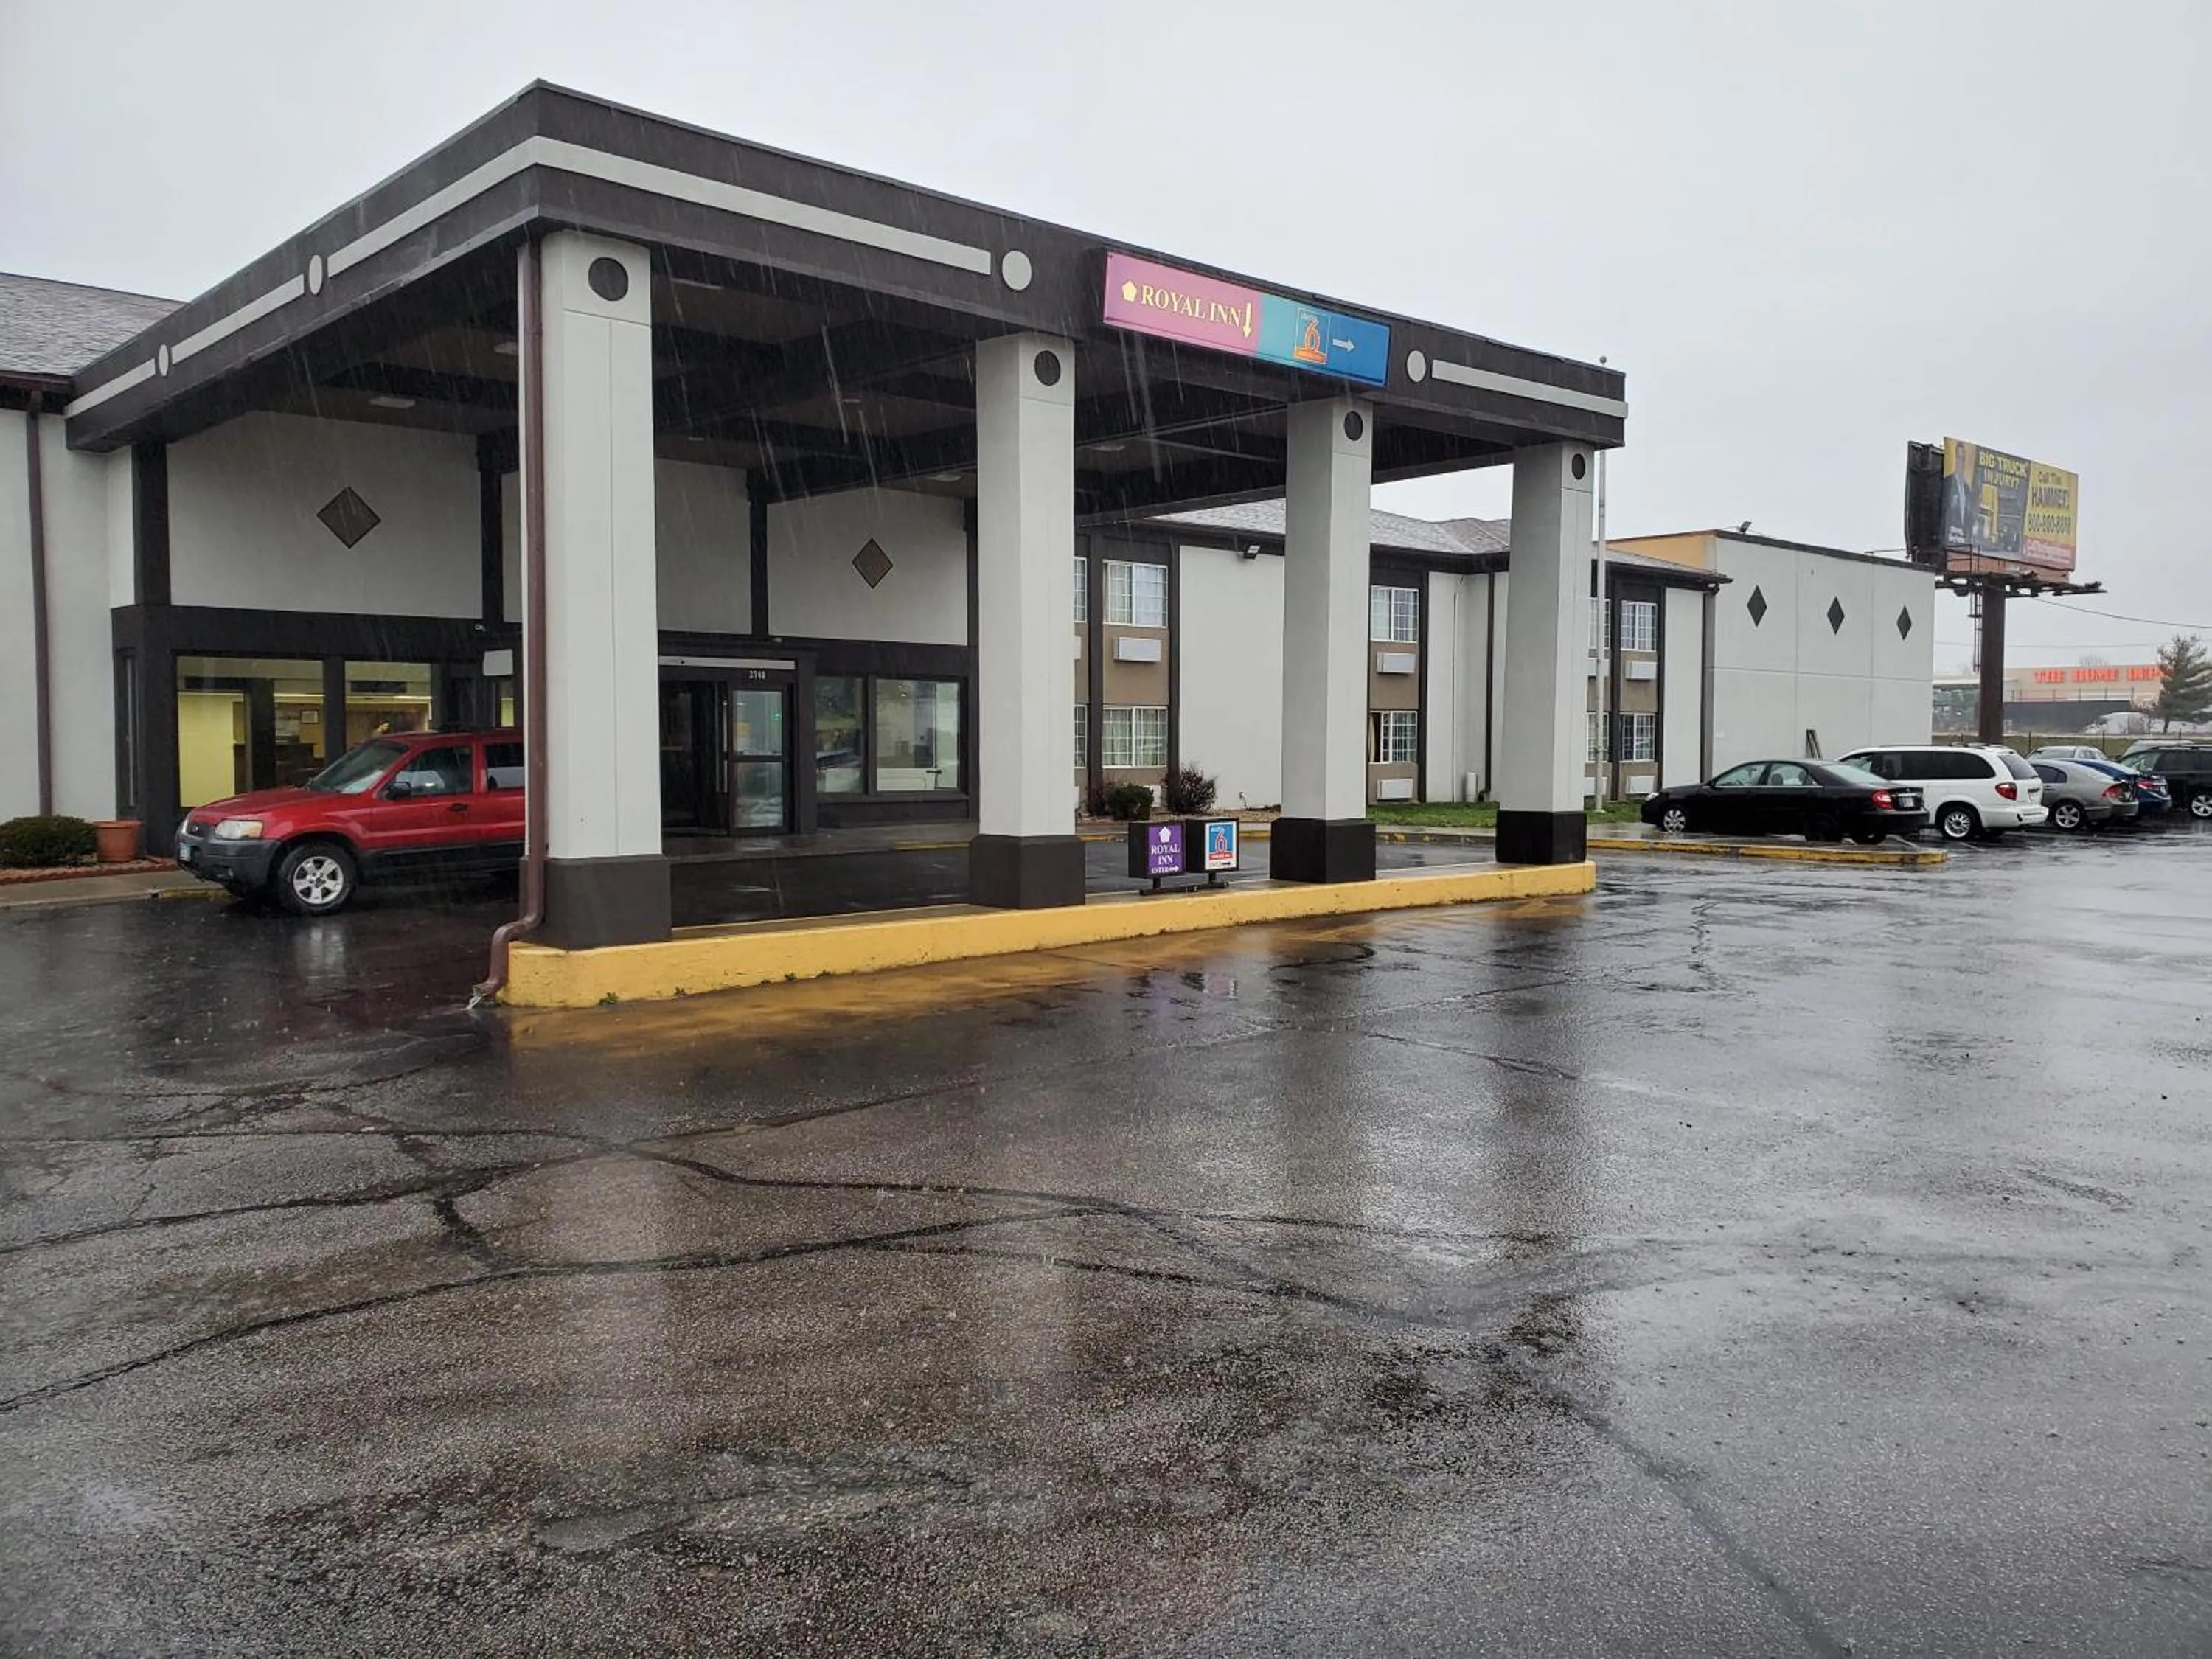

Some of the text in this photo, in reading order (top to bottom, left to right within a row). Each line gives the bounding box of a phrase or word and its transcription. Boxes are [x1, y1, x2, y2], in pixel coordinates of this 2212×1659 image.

[1141, 285, 1242, 328] ROYAL INN
[1979, 451, 1994, 469] BIG
[2034, 669, 2065, 684] THE
[2073, 667, 2120, 683] HOME
[1151, 843, 1180, 855] ROYAL
[1158, 855, 1174, 865] INN
